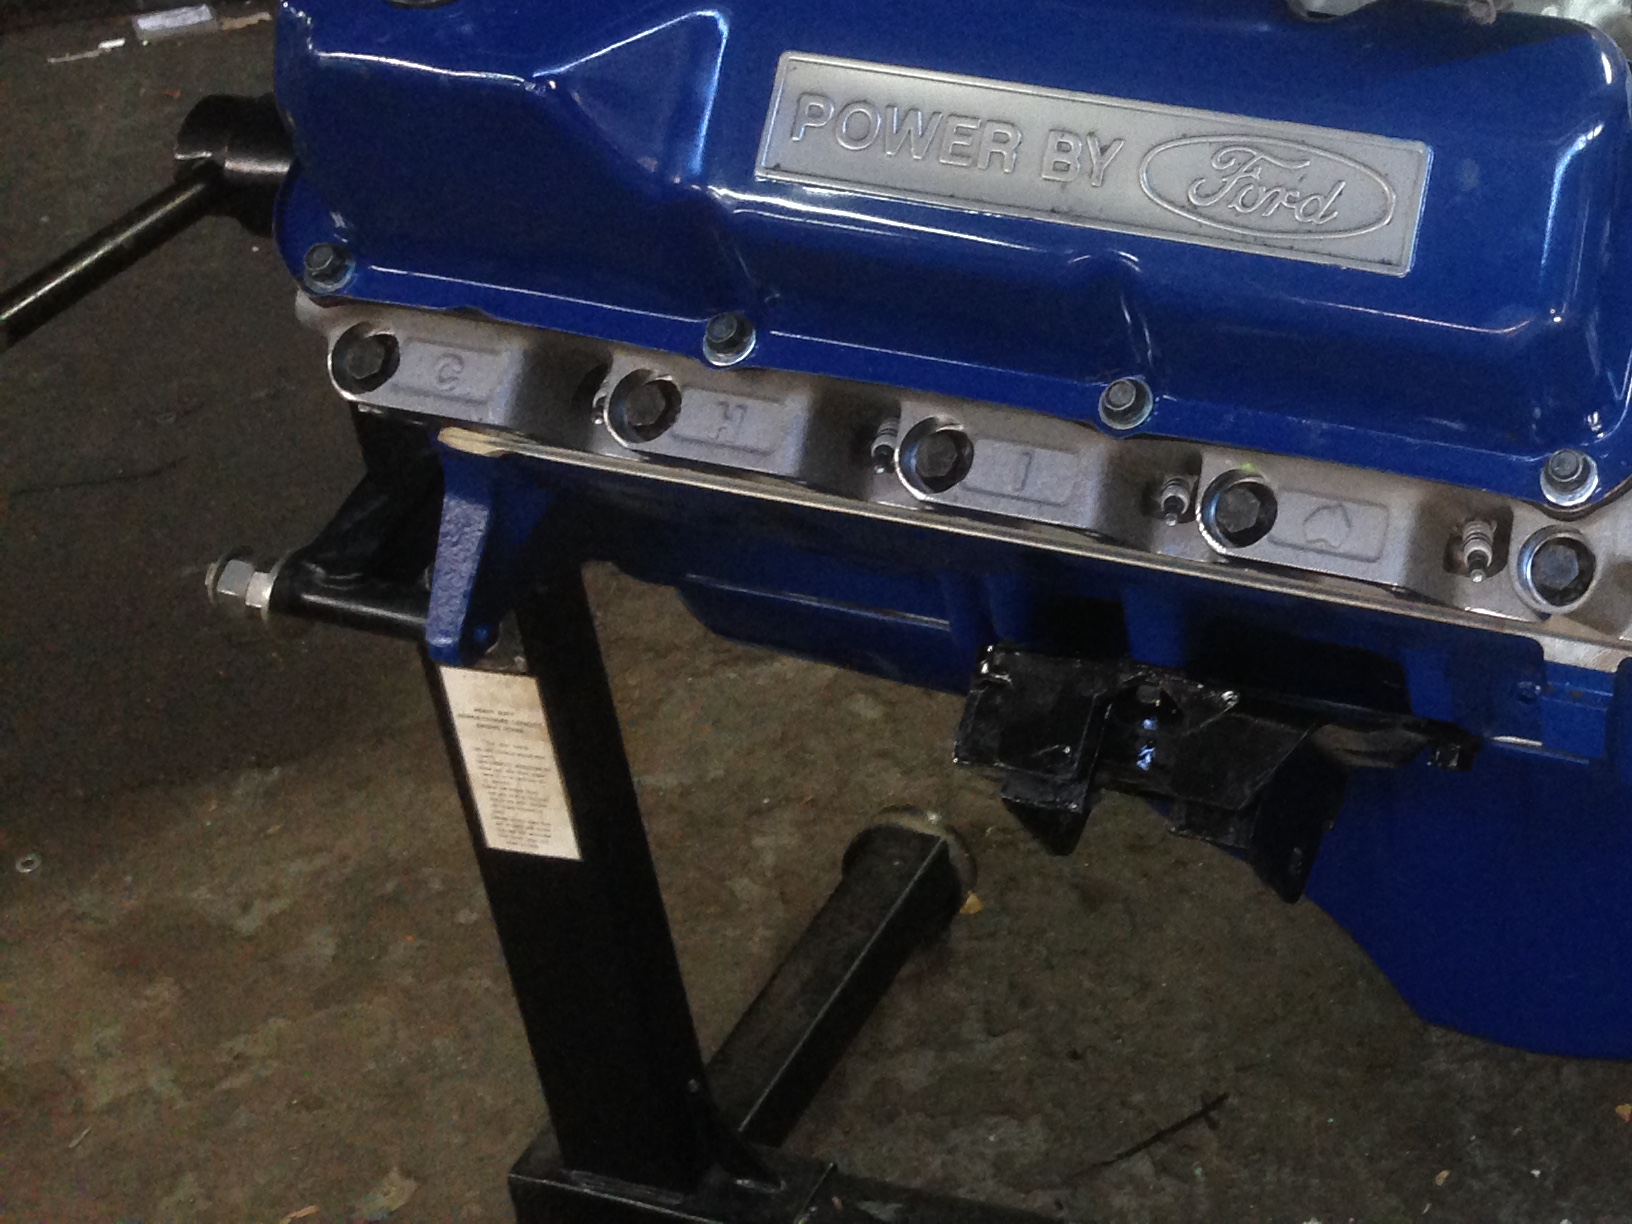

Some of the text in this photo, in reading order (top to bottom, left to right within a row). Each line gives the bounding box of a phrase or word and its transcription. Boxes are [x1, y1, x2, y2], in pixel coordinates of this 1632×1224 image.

[790, 91, 1347, 226] POWER BY Ford
